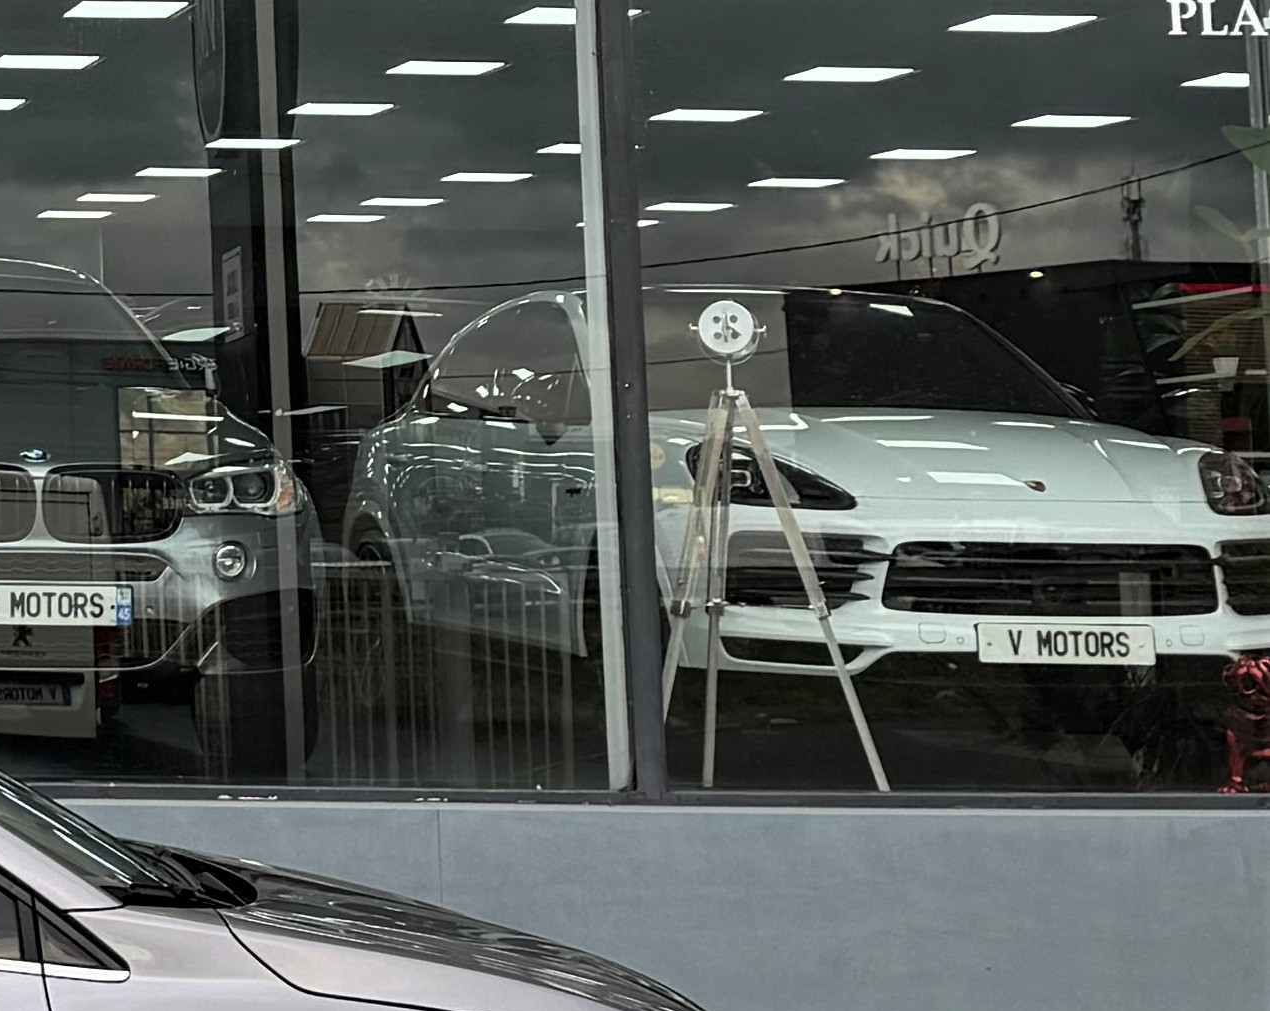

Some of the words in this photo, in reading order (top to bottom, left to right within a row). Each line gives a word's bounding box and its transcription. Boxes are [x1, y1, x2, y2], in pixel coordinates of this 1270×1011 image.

[1166, 0, 1270, 36] PLA
[10, 591, 104, 618] MOTORS
[117, 607, 131, 620] 45
[1008, 629, 1023, 656] V
[1036, 629, 1131, 658] MOTORS
